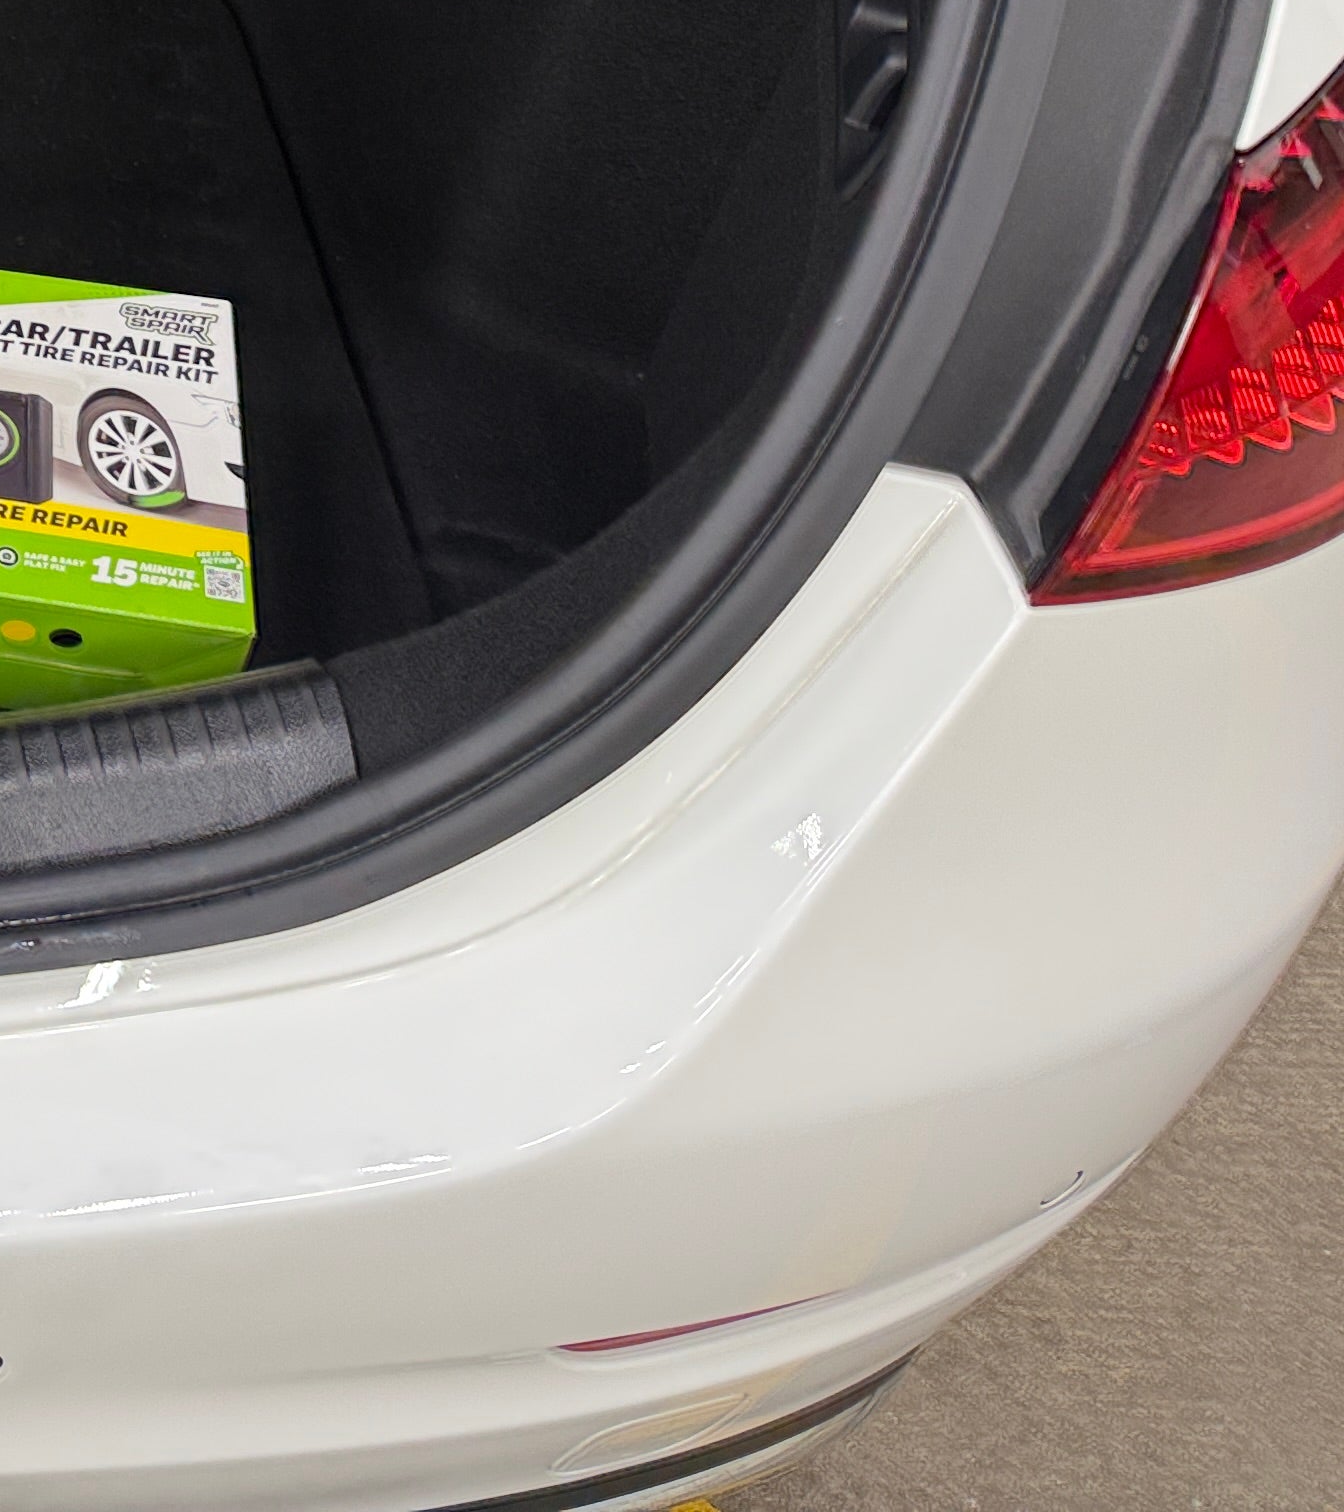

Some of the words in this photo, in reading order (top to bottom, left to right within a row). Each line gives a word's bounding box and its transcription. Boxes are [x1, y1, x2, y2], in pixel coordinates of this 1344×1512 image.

[124, 306, 212, 325] SMART
[130, 317, 208, 343] SPAIR
[19, 341, 75, 362] TIRE
[79, 351, 170, 378] REPAIR
[175, 366, 220, 385] KIT
[31, 506, 129, 537] REPAIR
[23, 551, 49, 561] SAFE
[59, 557, 86, 568] EASY
[23, 560, 49, 571] FLAT
[49, 562, 67, 573] FIX
[91, 555, 139, 588] 15
[140, 562, 196, 580] MINUTE
